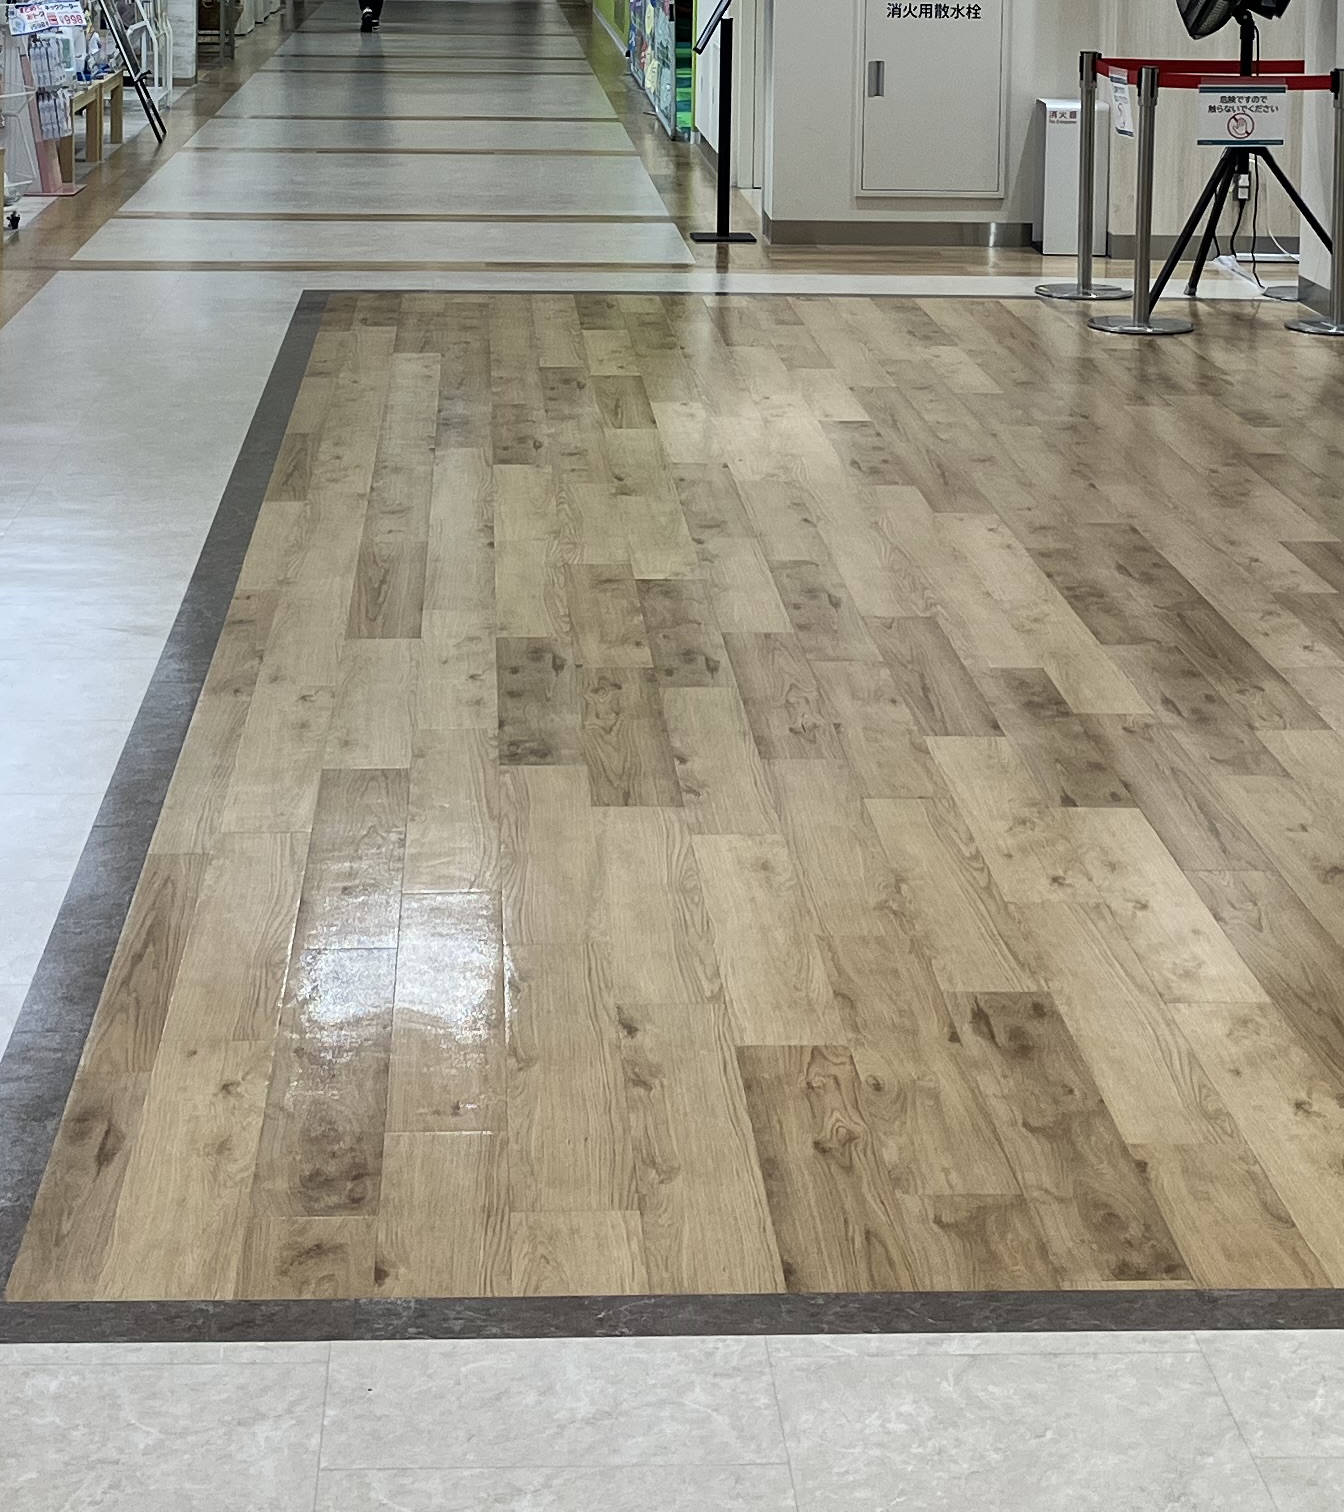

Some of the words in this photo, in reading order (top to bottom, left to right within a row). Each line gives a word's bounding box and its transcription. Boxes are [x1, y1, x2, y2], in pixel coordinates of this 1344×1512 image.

[886, 2, 982, 19] 消火用散水栓
[1219, 95, 1268, 104] 危険ですので
[1207, 104, 1279, 113] 触らないでください
